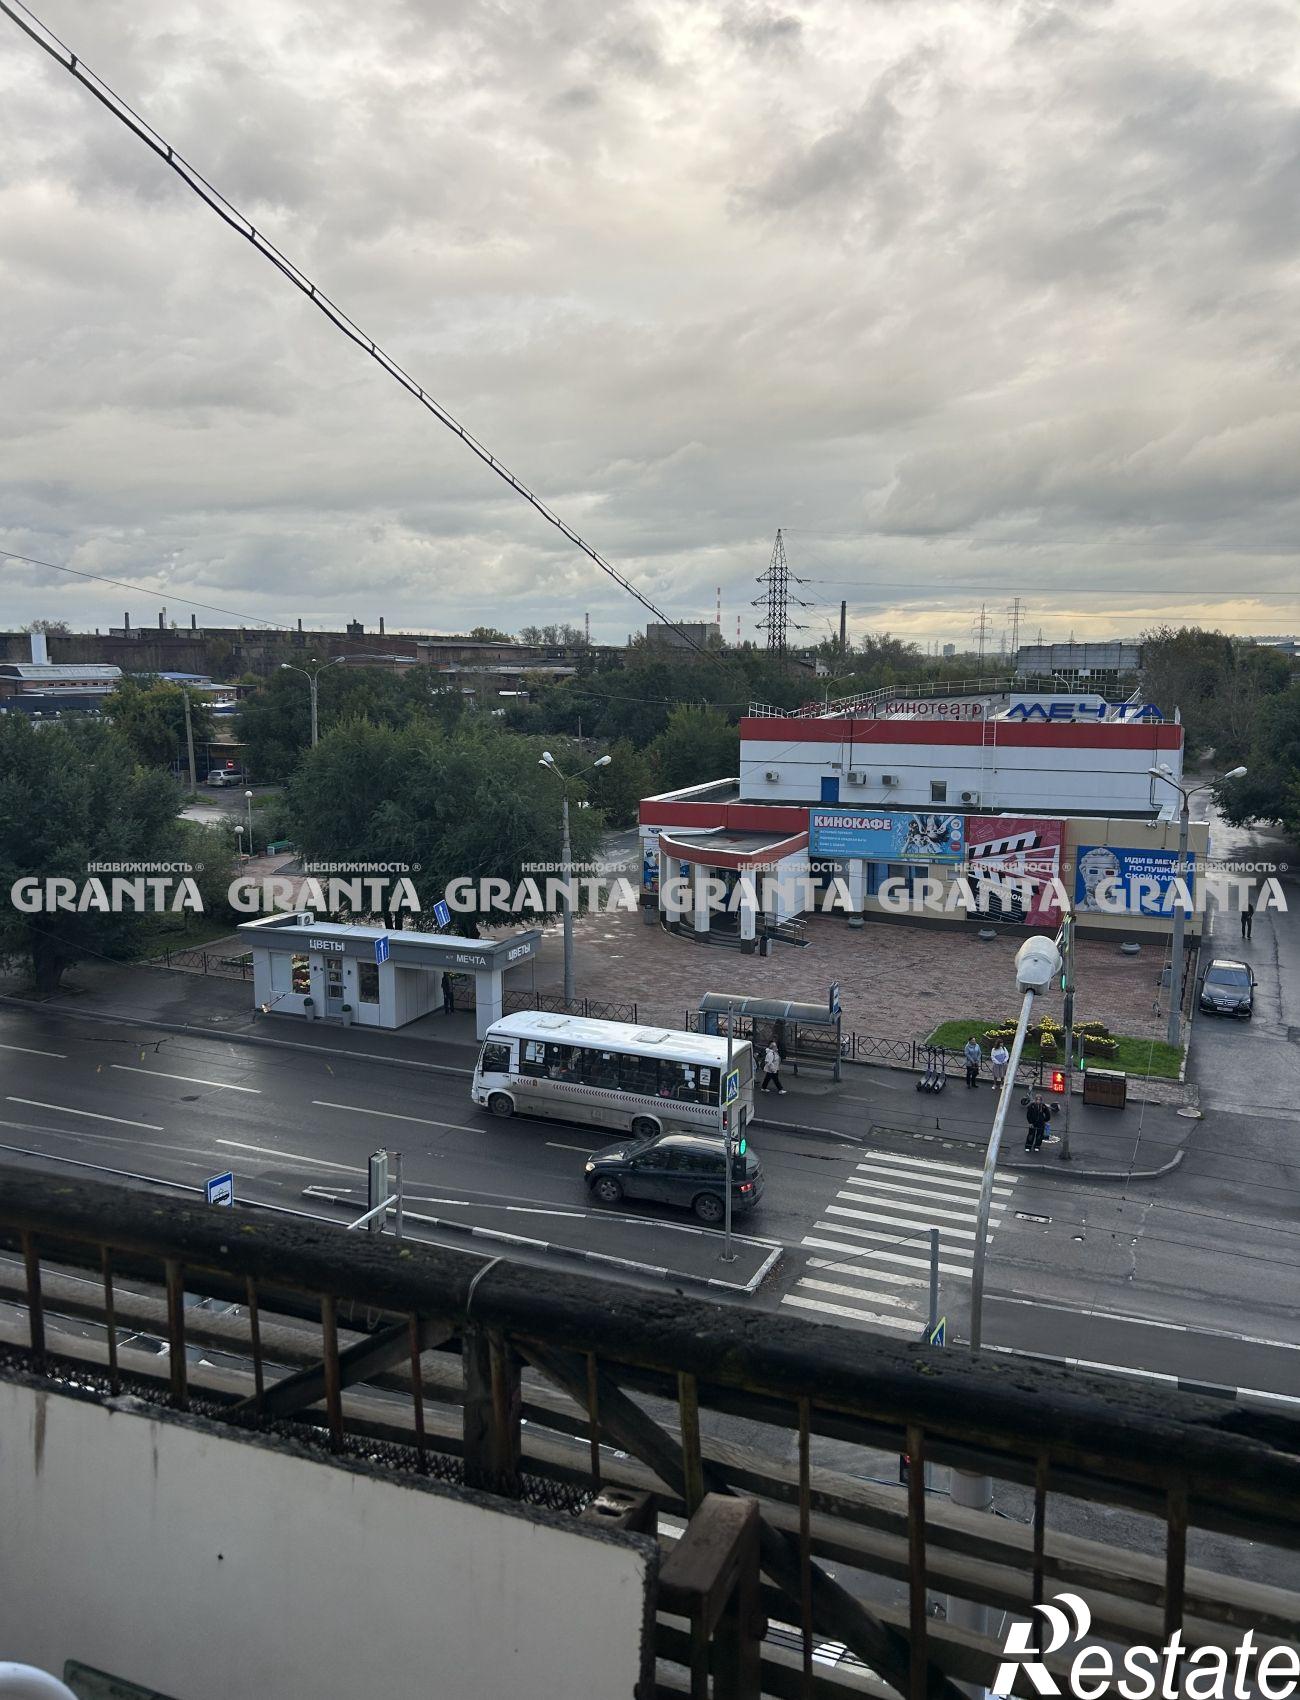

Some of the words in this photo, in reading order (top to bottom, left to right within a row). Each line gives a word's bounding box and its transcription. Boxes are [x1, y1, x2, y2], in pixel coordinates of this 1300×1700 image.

[885, 702, 983, 716] кинотеатр
[1005, 702, 1165, 719] МЕЧТА
[814, 815, 892, 831] КИНОКАФЕ
[1124, 856, 1146, 864] ИДИ
[309, 939, 345, 952] ЦВЕТЫ
[508, 943, 531, 960] ЦВЕТЫ
[456, 954, 486, 965] МЕЧТА
